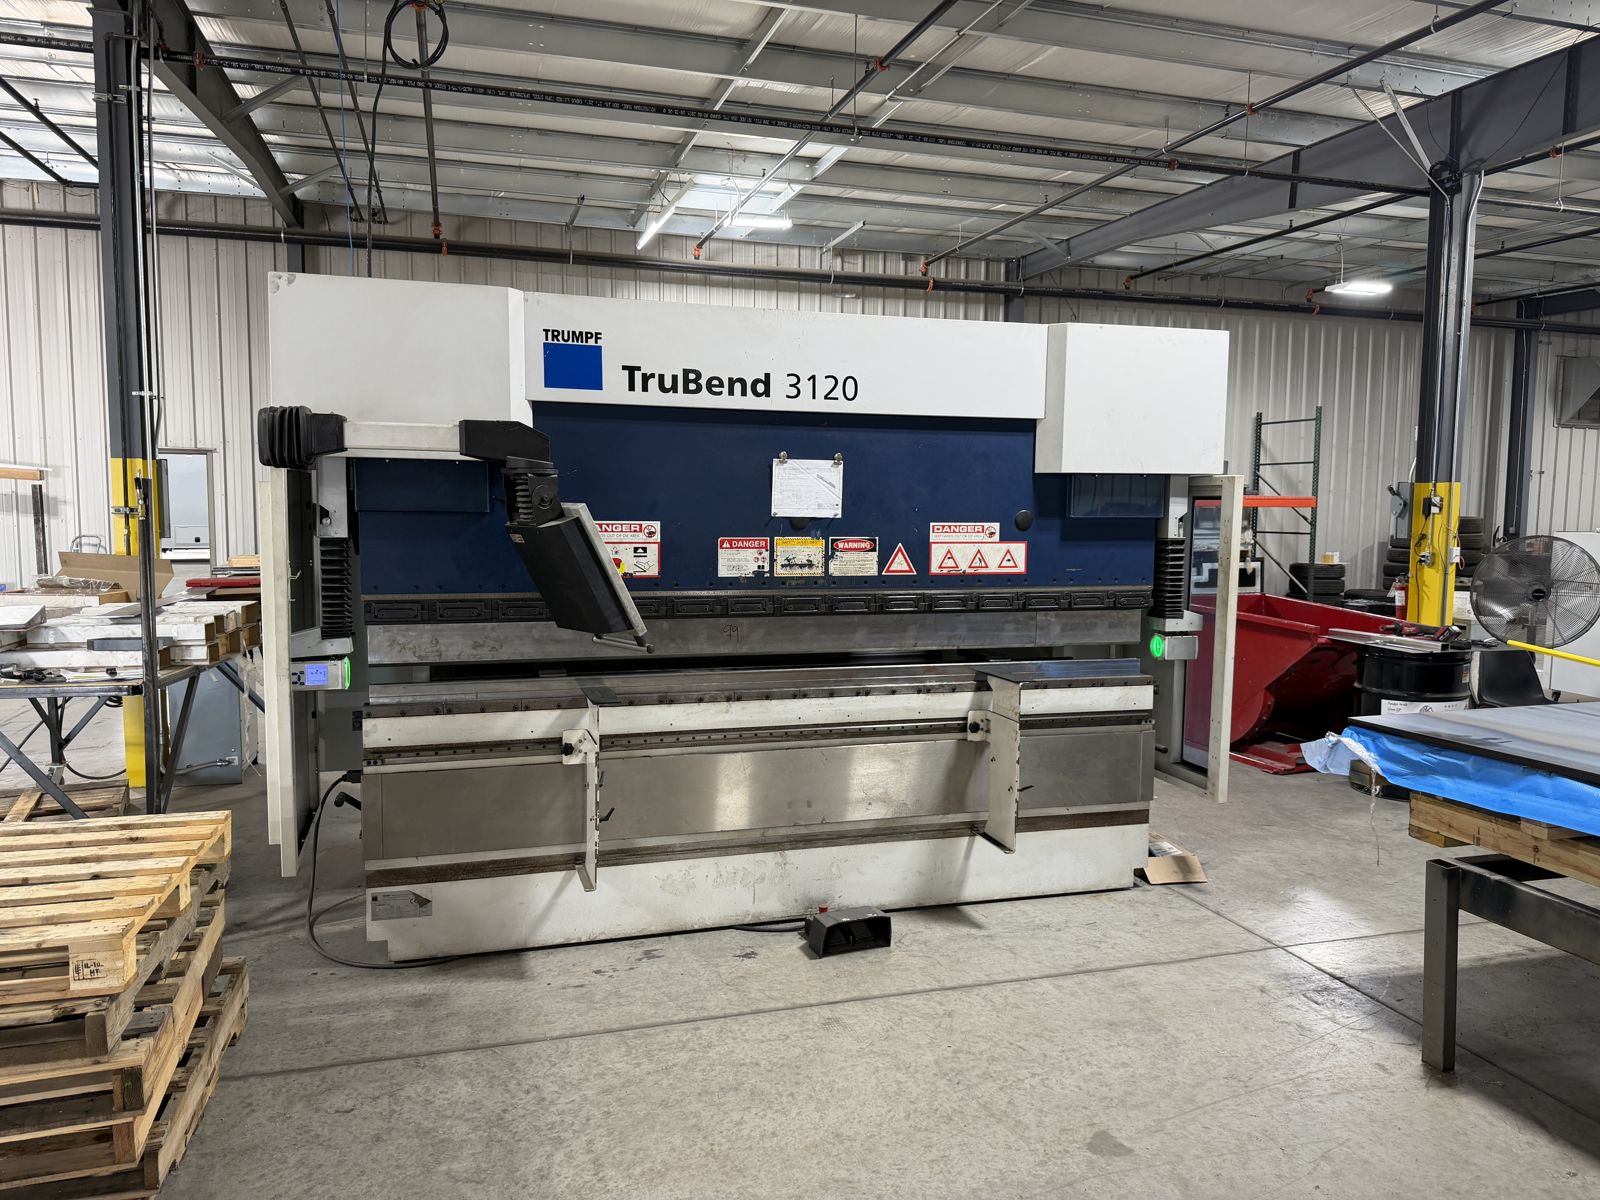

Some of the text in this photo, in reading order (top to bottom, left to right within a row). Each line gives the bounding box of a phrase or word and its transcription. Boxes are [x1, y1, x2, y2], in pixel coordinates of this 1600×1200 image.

[542, 328, 603, 345] TRUMPF
[621, 364, 859, 401] TruBend 3120
[933, 525, 983, 533] DANGER
[731, 540, 766, 548] DANGER
[837, 541, 871, 549] WARNING
